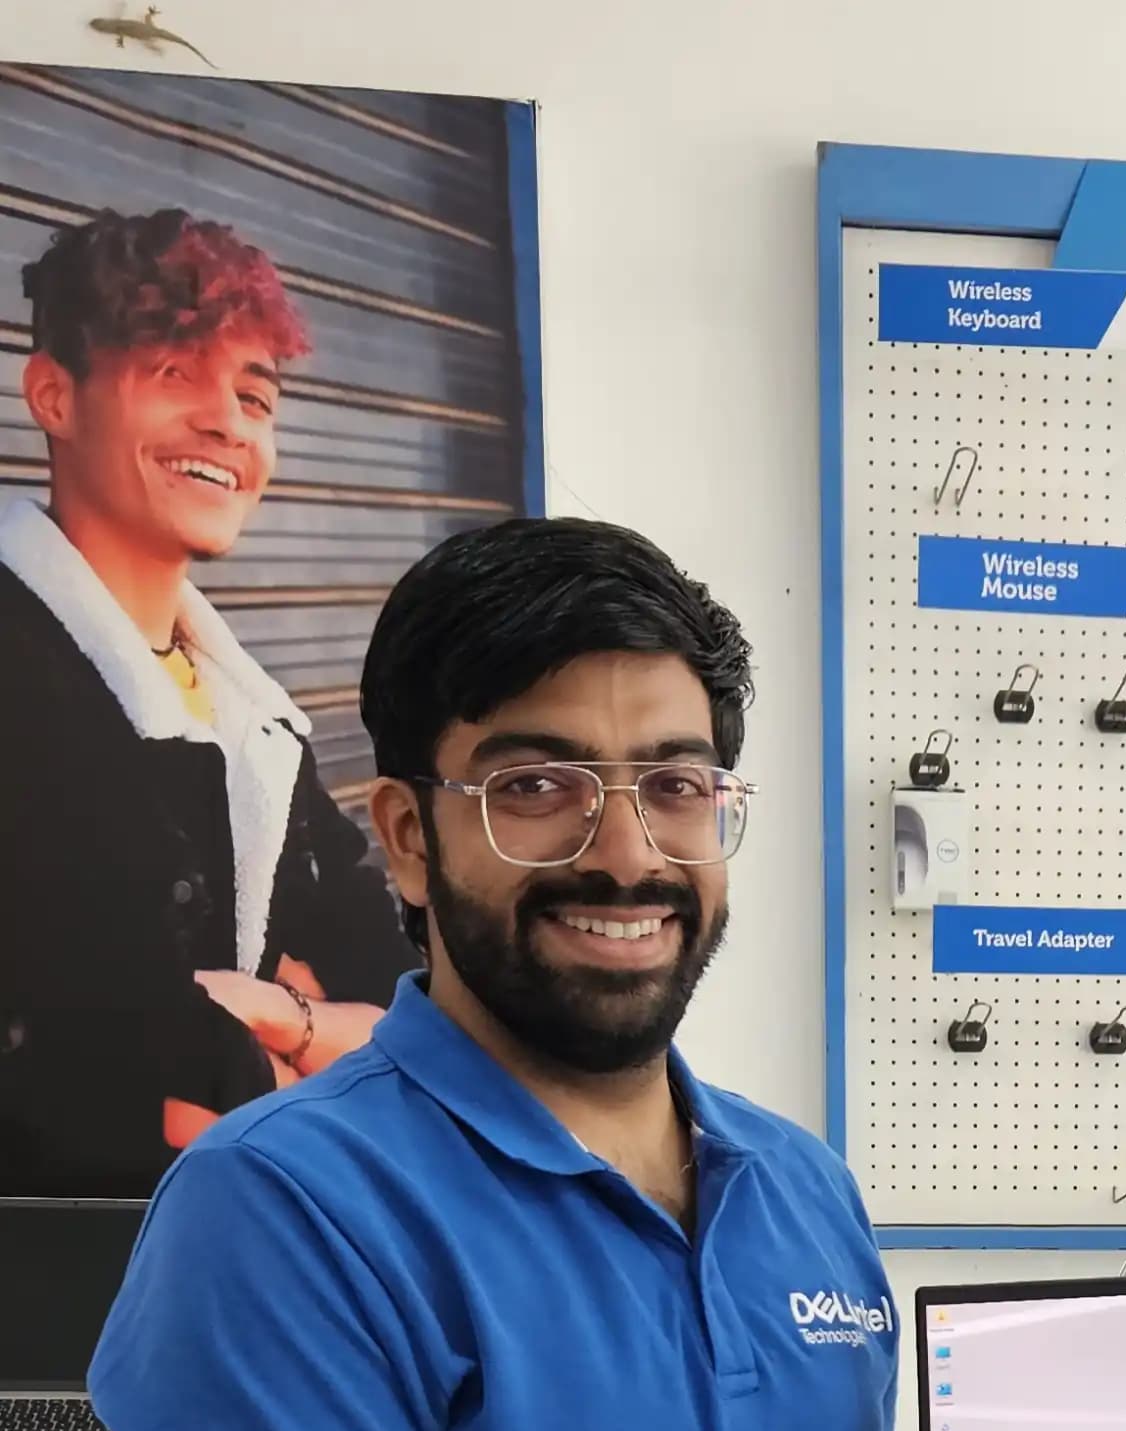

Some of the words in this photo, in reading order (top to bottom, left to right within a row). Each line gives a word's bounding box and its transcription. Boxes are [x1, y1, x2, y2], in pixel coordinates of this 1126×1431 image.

[948, 280, 1033, 302] Wireless
[947, 308, 1042, 331] Keyboard
[982, 552, 1079, 580] Wireless
[981, 577, 1058, 602] Mouse
[973, 928, 1033, 948] Travel
[1037, 929, 1114, 952] Adapter
[798, 1328, 868, 1347] Technolog
